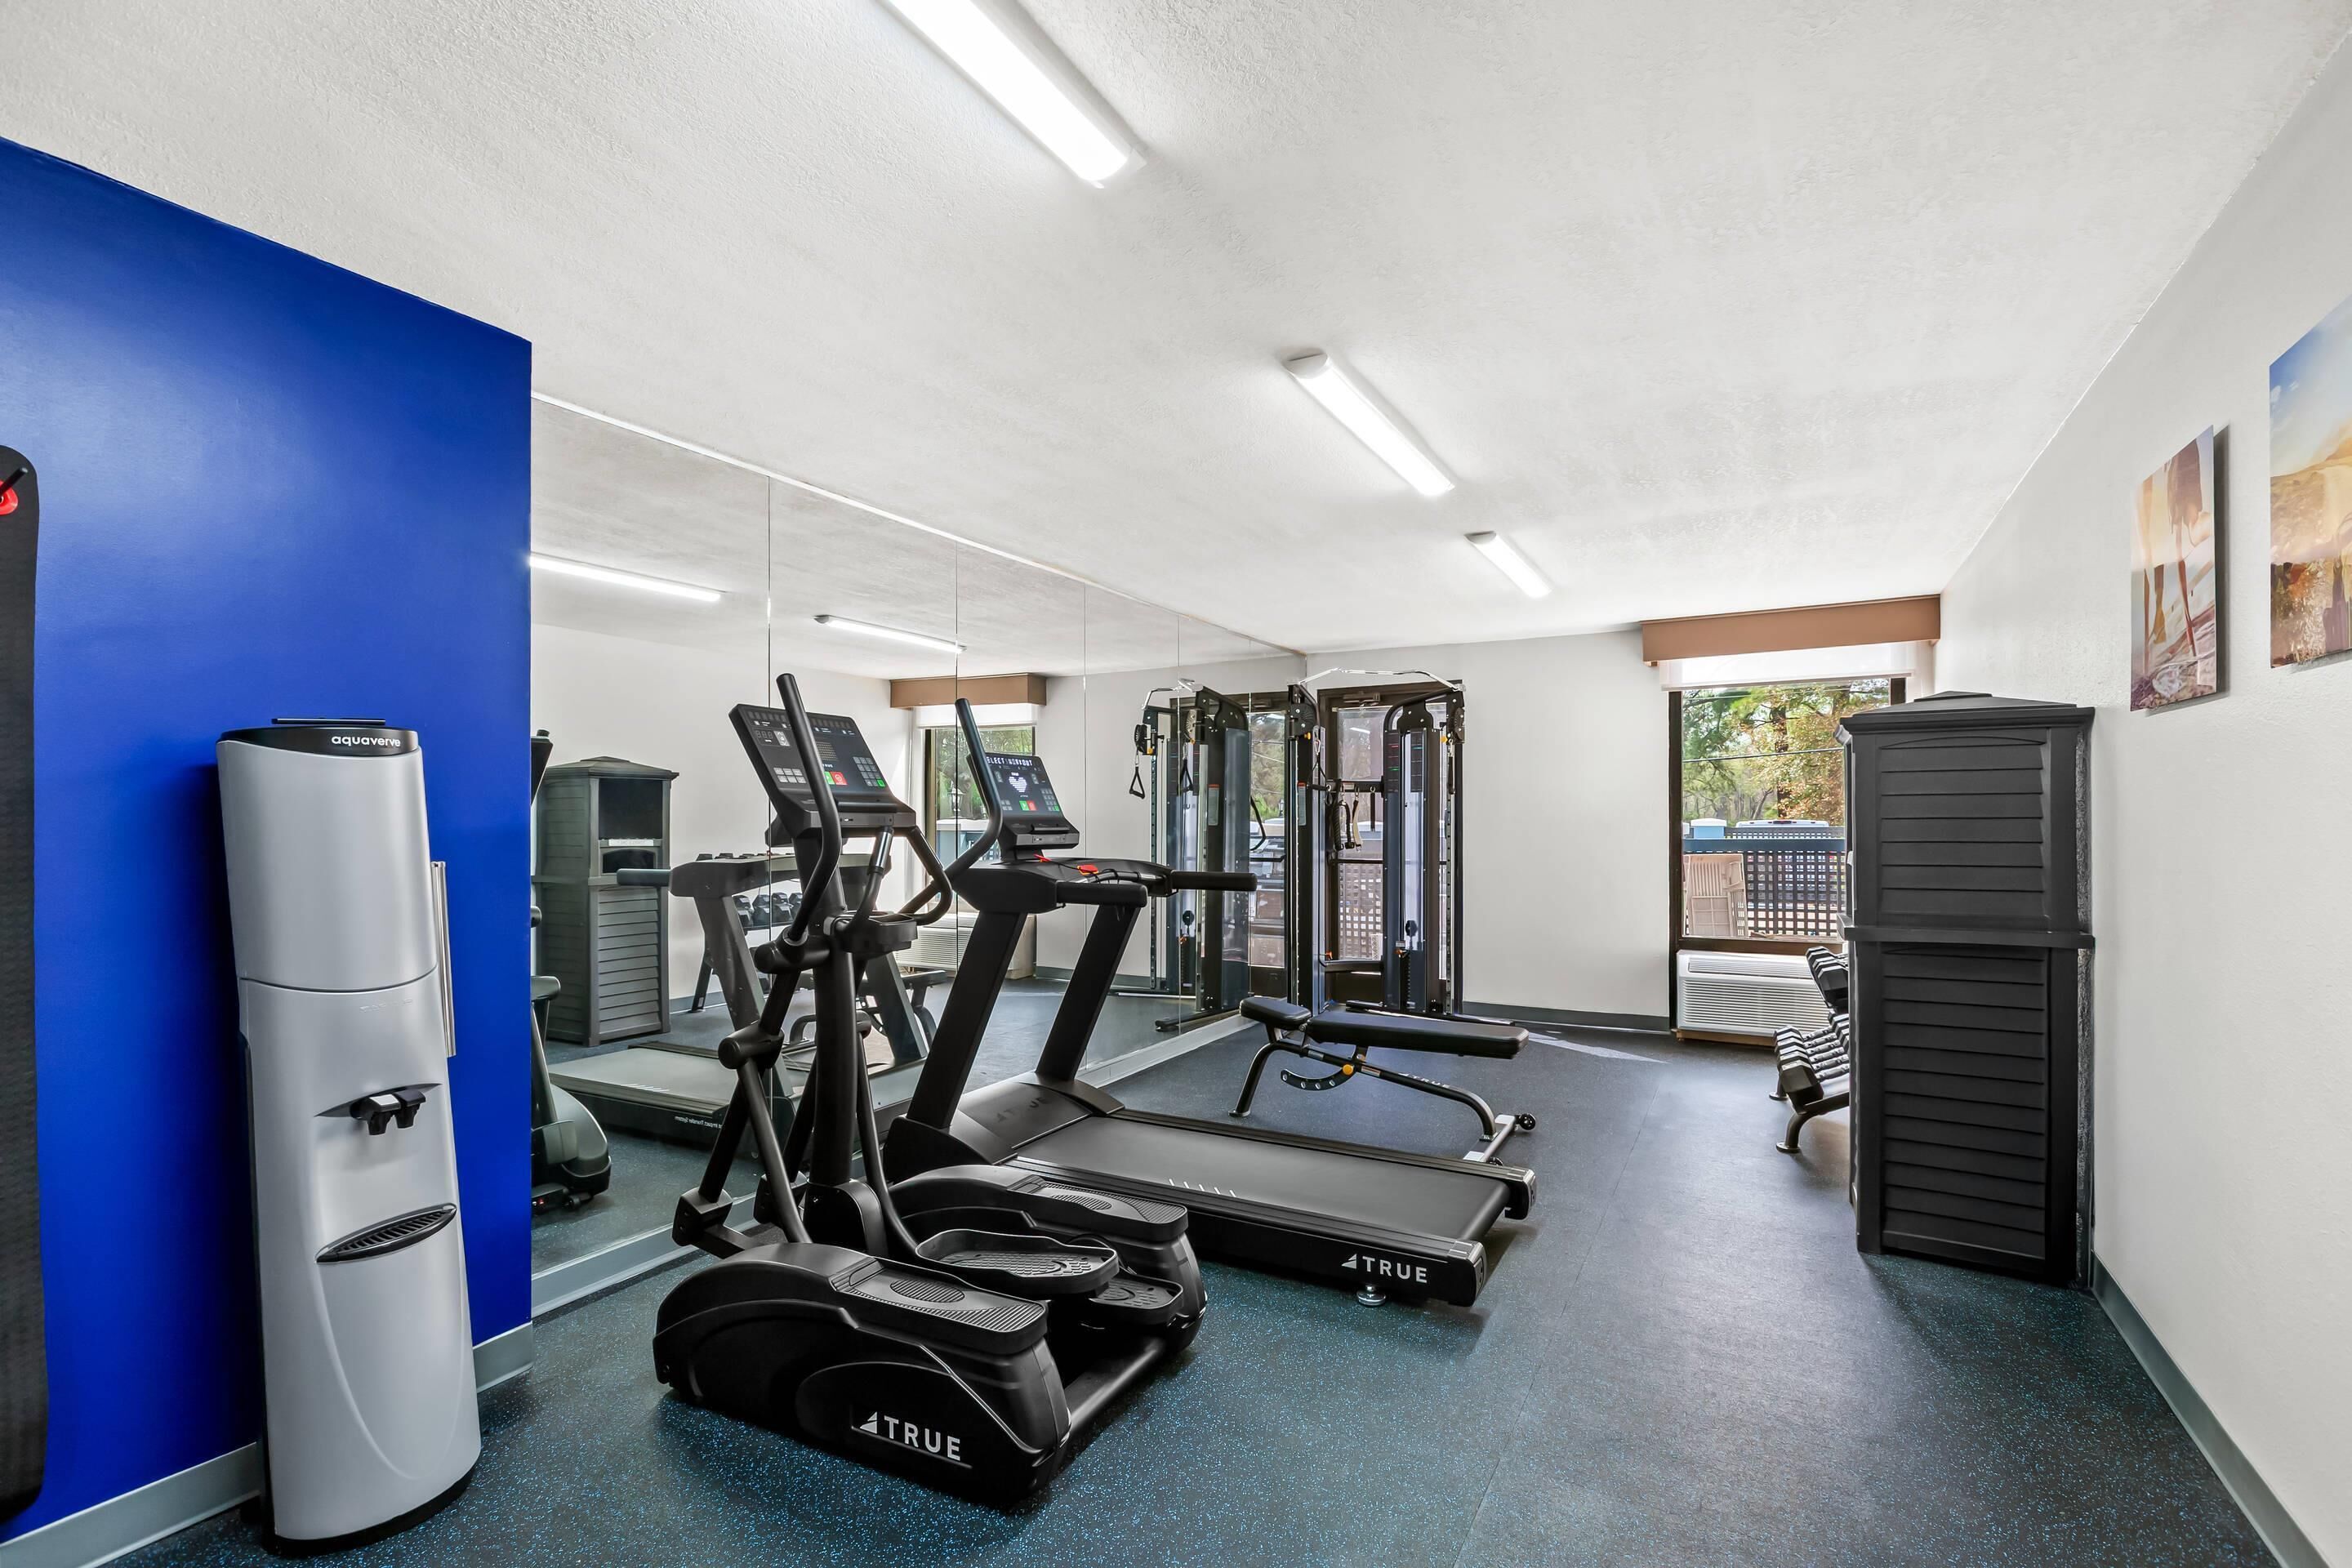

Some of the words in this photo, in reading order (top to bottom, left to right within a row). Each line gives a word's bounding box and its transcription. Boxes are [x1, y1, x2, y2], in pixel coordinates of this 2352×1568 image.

[332, 736, 401, 746] aquaverve
[986, 756, 1005, 764] ELECT
[1362, 1255, 1428, 1284] TRUE
[884, 1414, 961, 1461] TRUE
